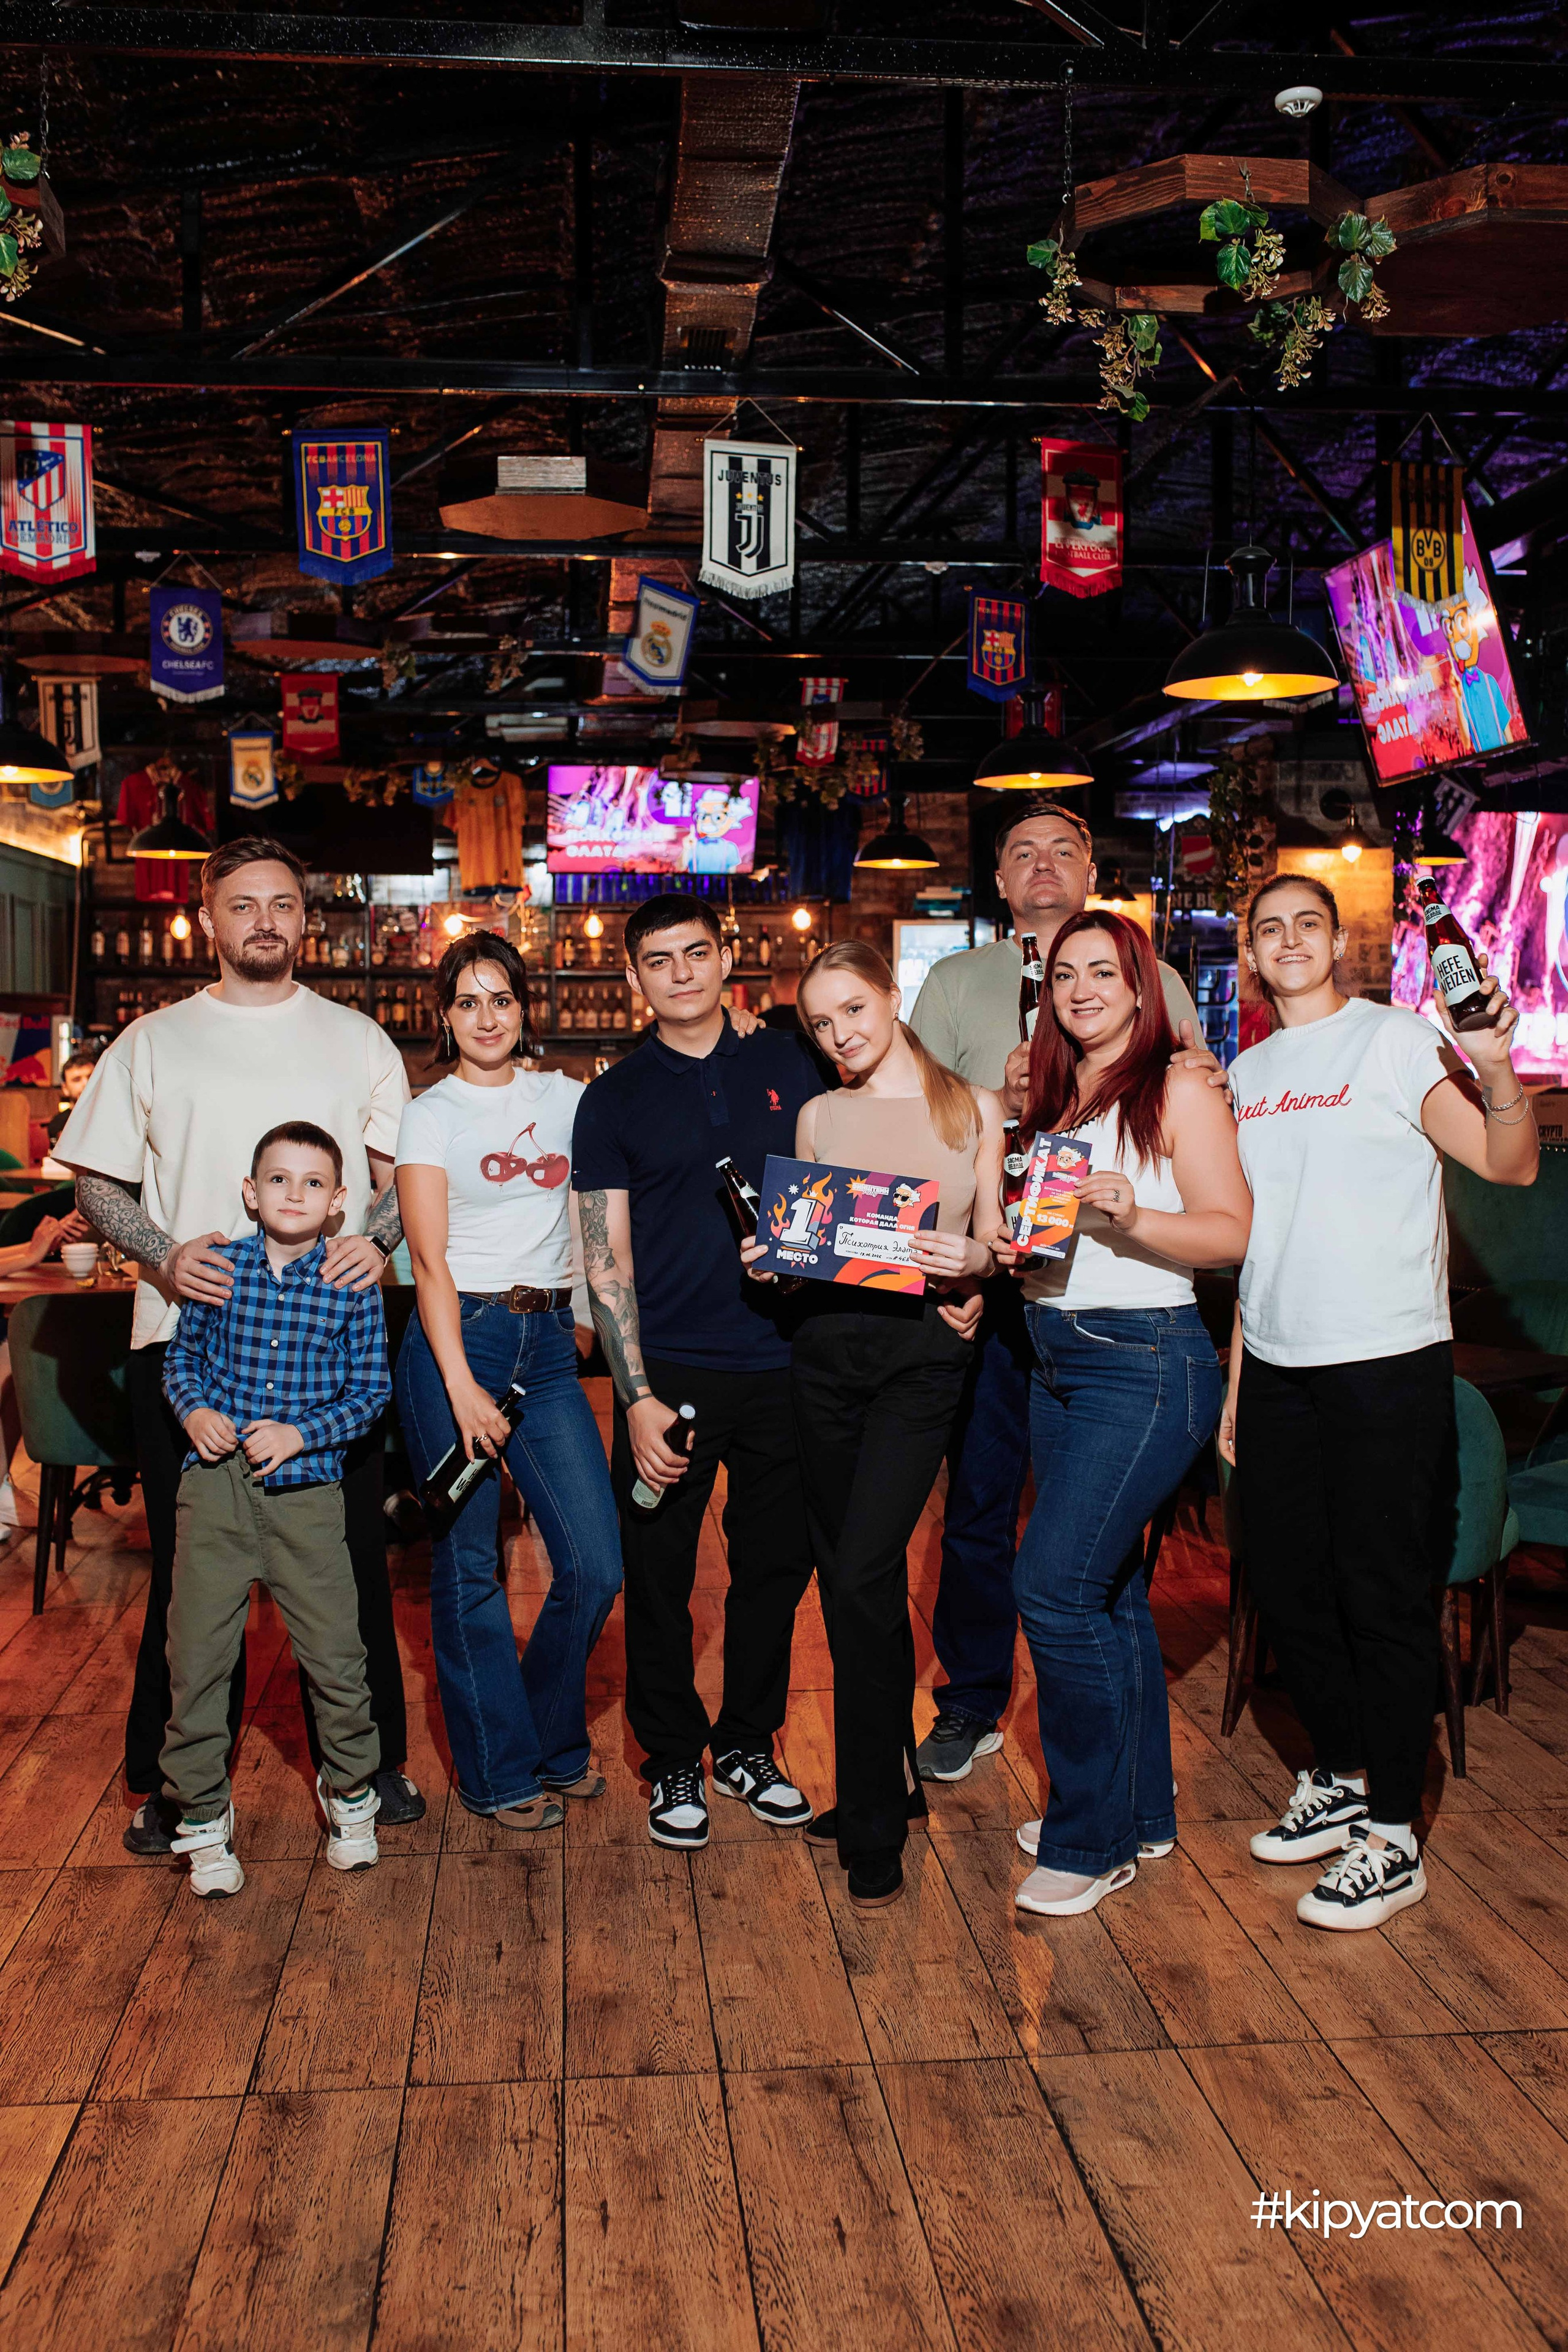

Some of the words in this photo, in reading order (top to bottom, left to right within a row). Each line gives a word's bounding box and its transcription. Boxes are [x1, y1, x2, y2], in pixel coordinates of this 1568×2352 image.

[718, 469, 782, 486] JUVENTUS
[1417, 530, 1442, 557] BVB
[1424, 557, 1434, 567] 09
[1437, 955, 1463, 978] HEFE
[1268, 1084, 1352, 1115] Animal
[1017, 1137, 1052, 1246] СЕРТИФИКАТ
[780, 1198, 820, 1246] 1
[850, 1216, 879, 1226] КОТОРАЯ
[867, 1212, 900, 1223] КОМАНДА,
[1048, 1215, 1069, 1227] 000
[839, 1232, 889, 1251] Психотрия
[776, 1248, 818, 1265] МЕСТО
